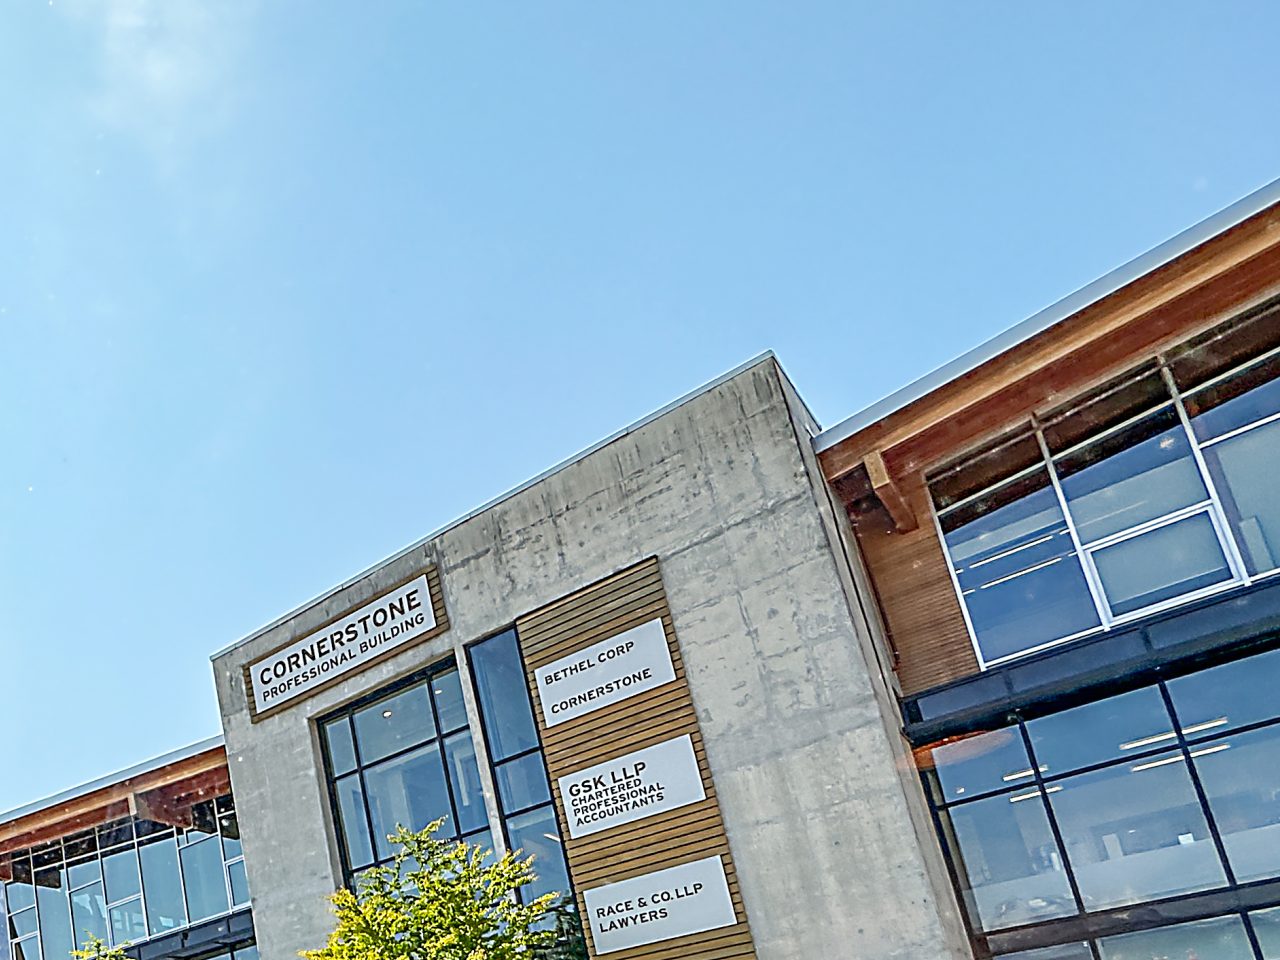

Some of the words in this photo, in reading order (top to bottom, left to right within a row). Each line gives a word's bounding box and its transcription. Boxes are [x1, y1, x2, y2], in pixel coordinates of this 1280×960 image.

[260, 589, 422, 685] CORNERSTONE
[263, 649, 356, 702] PROFESSIONAL
[360, 612, 424, 654] BUILDING
[544, 659, 595, 685] BETHEL
[598, 641, 634, 663] CORP
[551, 668, 652, 714] CORNERSTONE
[569, 775, 606, 797] GSK
[610, 761, 646, 784] LLP
[571, 778, 642, 807] CHARTERED
[573, 782, 665, 817] PROFESSIONAL
[576, 792, 664, 827] ACCOUNTANTS
[596, 900, 634, 918] RACE
[638, 897, 647, 908] &
[675, 883, 703, 899] LLP
[599, 908, 668, 933] LAWYERS
